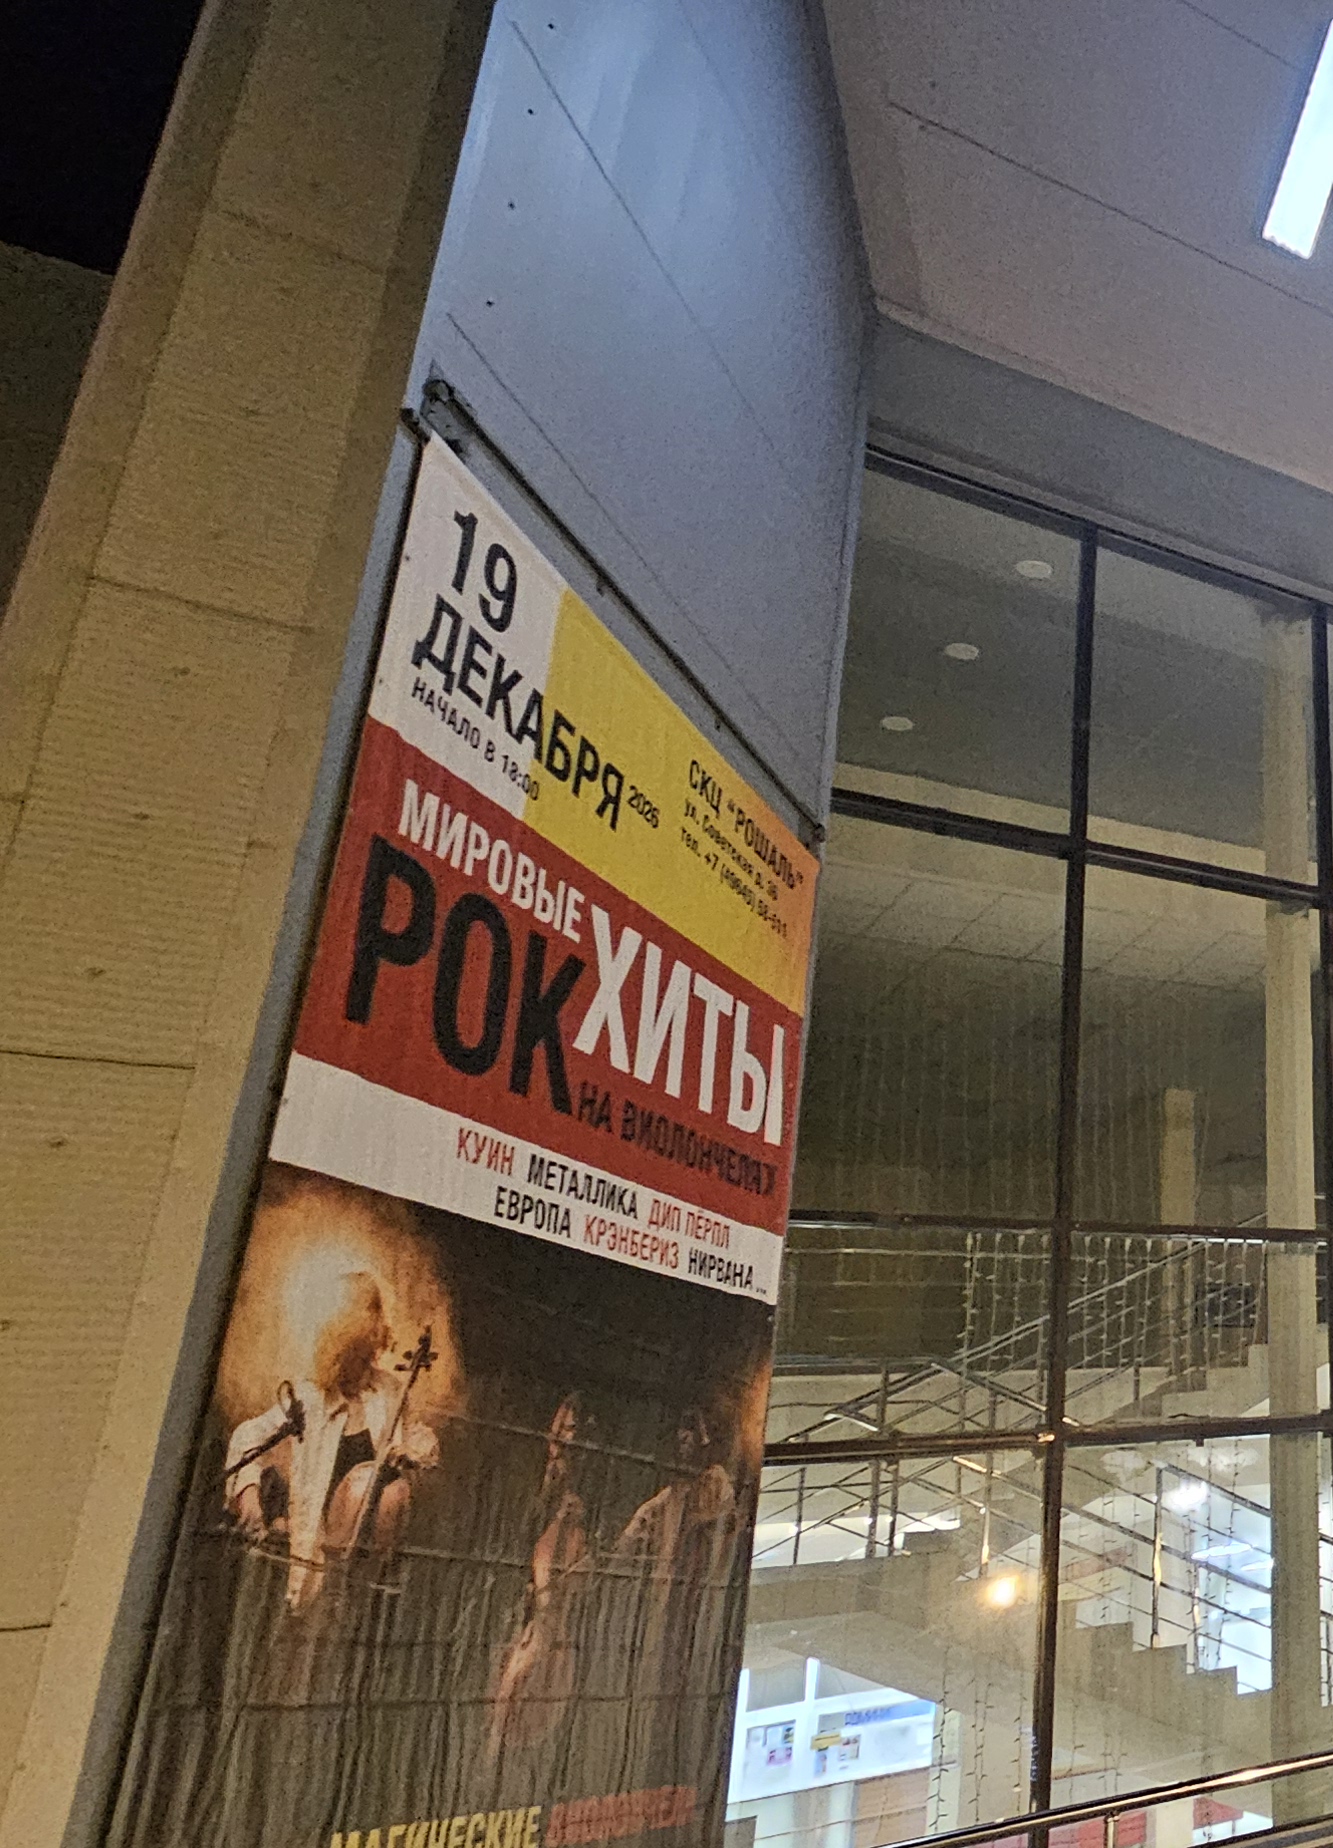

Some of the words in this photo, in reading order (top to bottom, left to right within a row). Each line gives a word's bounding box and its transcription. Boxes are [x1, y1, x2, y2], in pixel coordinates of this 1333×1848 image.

[452, 510, 518, 633] 19
[410, 593, 625, 833] ДЕКАБРЯ
[626, 784, 660, 829] 2026
[411, 676, 481, 749] НАЧАЛО
[484, 740, 496, 762] В
[501, 755, 540, 801] 18:00
[680, 826, 701, 858] тел.
[704, 852, 719, 871] +7
[683, 798, 700, 826] ул.
[689, 759, 723, 819] СКЦ
[398, 779, 588, 943] МИРОВЫЕ
[345, 834, 586, 1116] РОК
[572, 903, 785, 1147] ХИТЫ
[578, 1079, 614, 1134] НА
[456, 1127, 515, 1177] КУИН
[527, 1153, 638, 1220] МЕТАЛЛИКА
[648, 1198, 681, 1232] ДИП
[686, 1211, 730, 1249] ПЕРПЛ
[494, 1186, 572, 1238] ЕВРОПА
[583, 1214, 680, 1269] КРЭНБЕРИЗ
